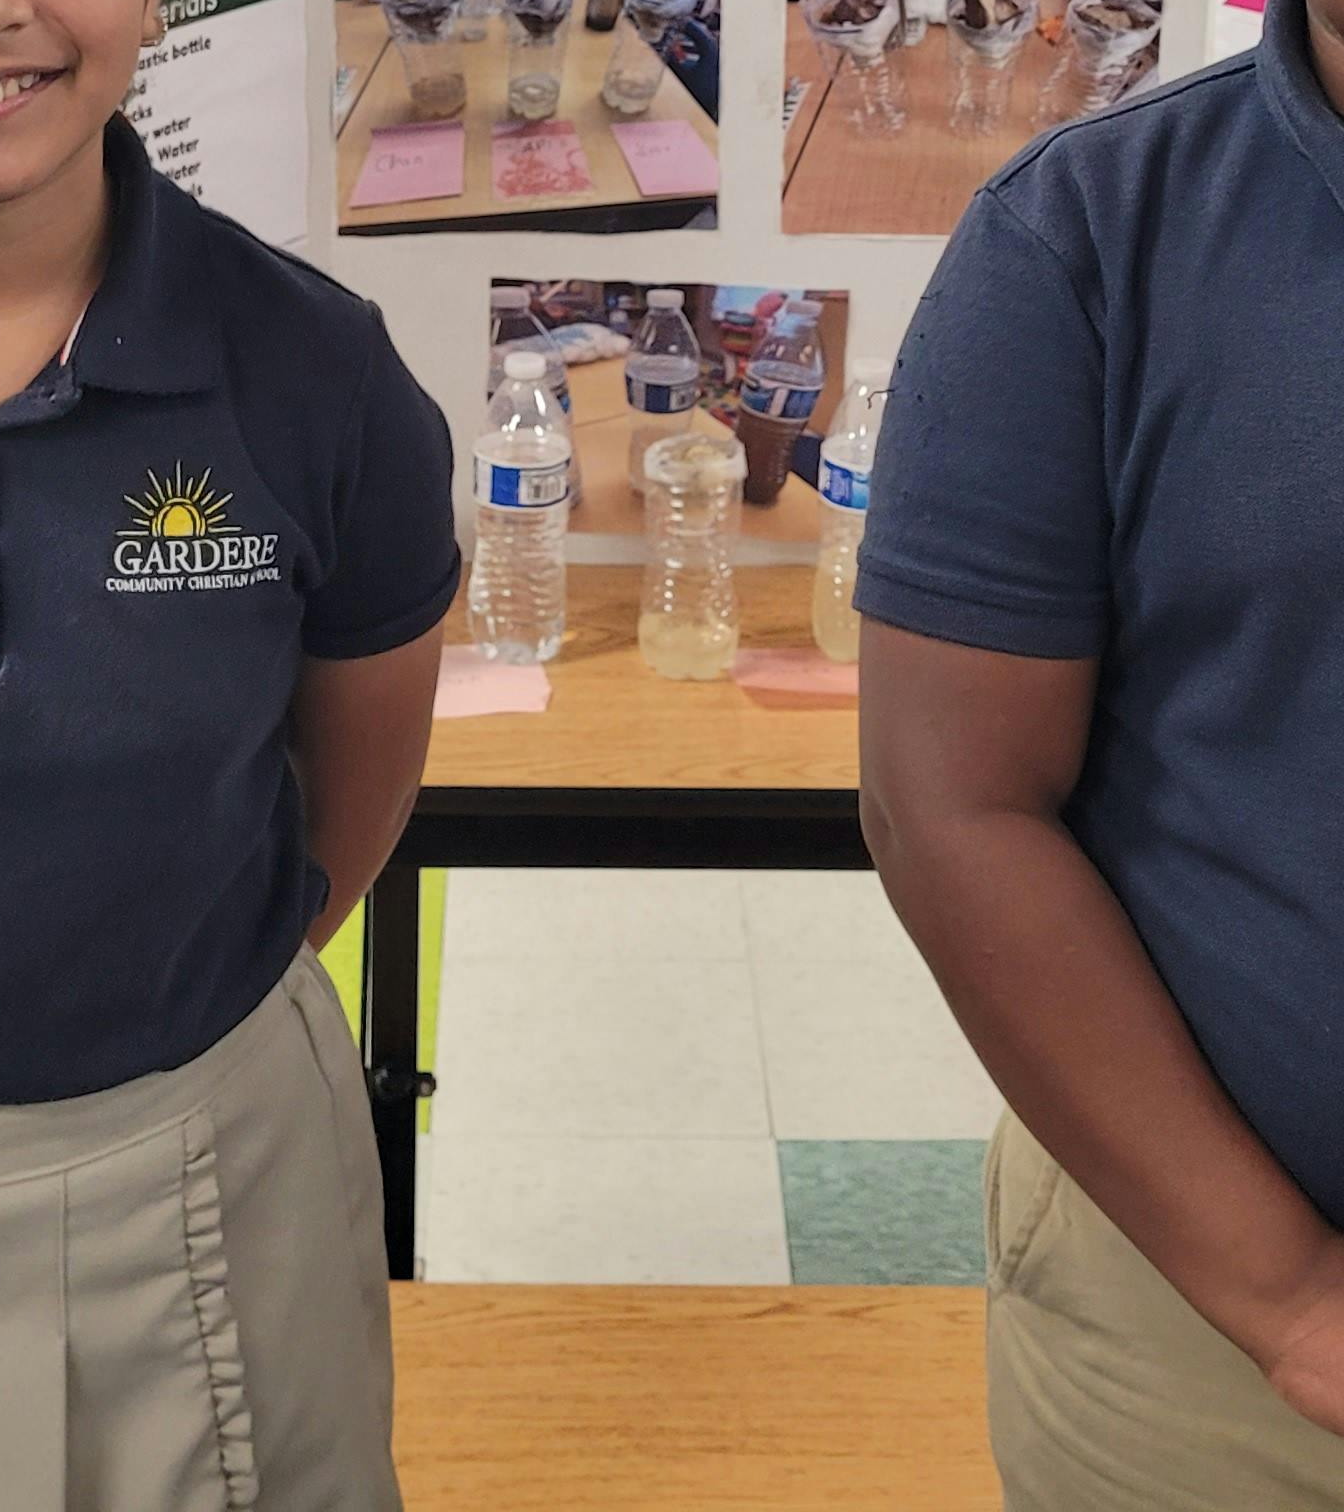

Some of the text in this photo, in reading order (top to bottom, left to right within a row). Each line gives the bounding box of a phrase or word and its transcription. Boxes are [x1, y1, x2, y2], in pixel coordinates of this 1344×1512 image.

[173, 36, 211, 60] bottle
[153, 116, 191, 138] water
[158, 139, 200, 161] Water
[114, 534, 278, 575] GARDERE
[106, 576, 186, 593] COMMUNITY
[188, 572, 249, 591] CHRISTIAN
